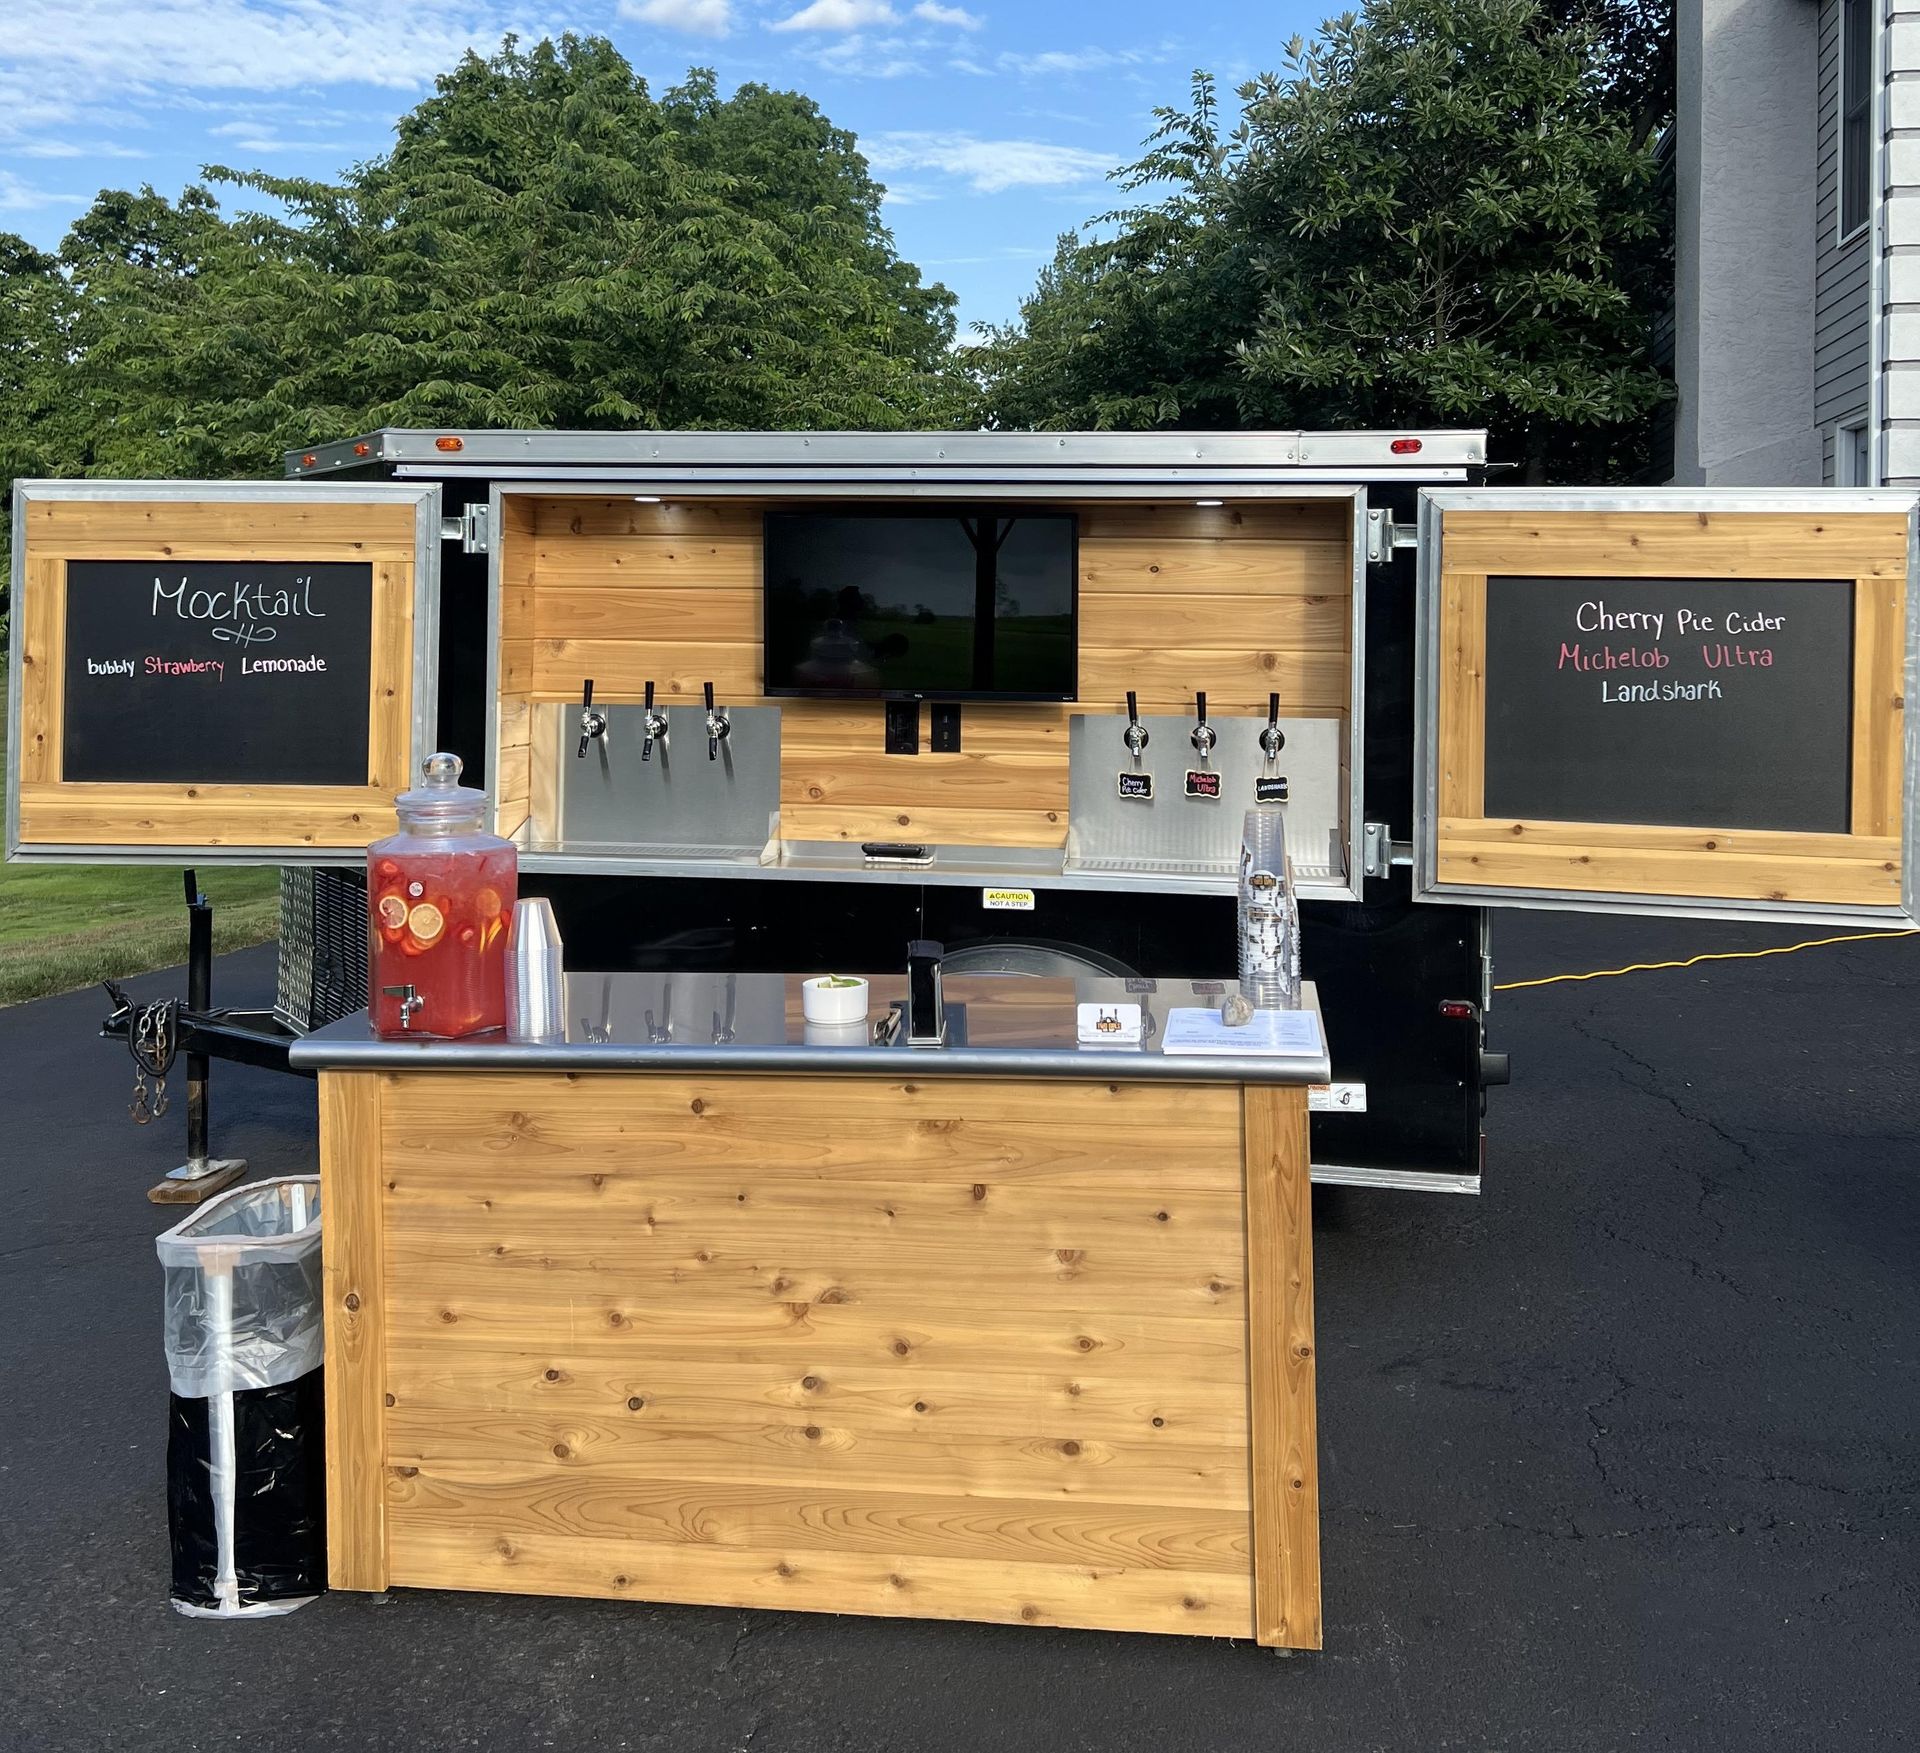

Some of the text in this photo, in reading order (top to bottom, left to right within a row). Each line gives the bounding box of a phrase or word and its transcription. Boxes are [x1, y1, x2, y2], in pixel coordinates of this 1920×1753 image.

[152, 576, 326, 620] Mocktail
[1576, 600, 1786, 641] Cherry Pie Cider
[87, 655, 327, 682] bubbly Strawberry Lemonade
[1557, 642, 1773, 672] Michelob Ultra
[1602, 679, 1723, 703] Landshark
[1121, 785, 1132, 794] Pie
[1122, 776, 1144, 789] Cherry
[995, 892, 1029, 900] CAUTION
